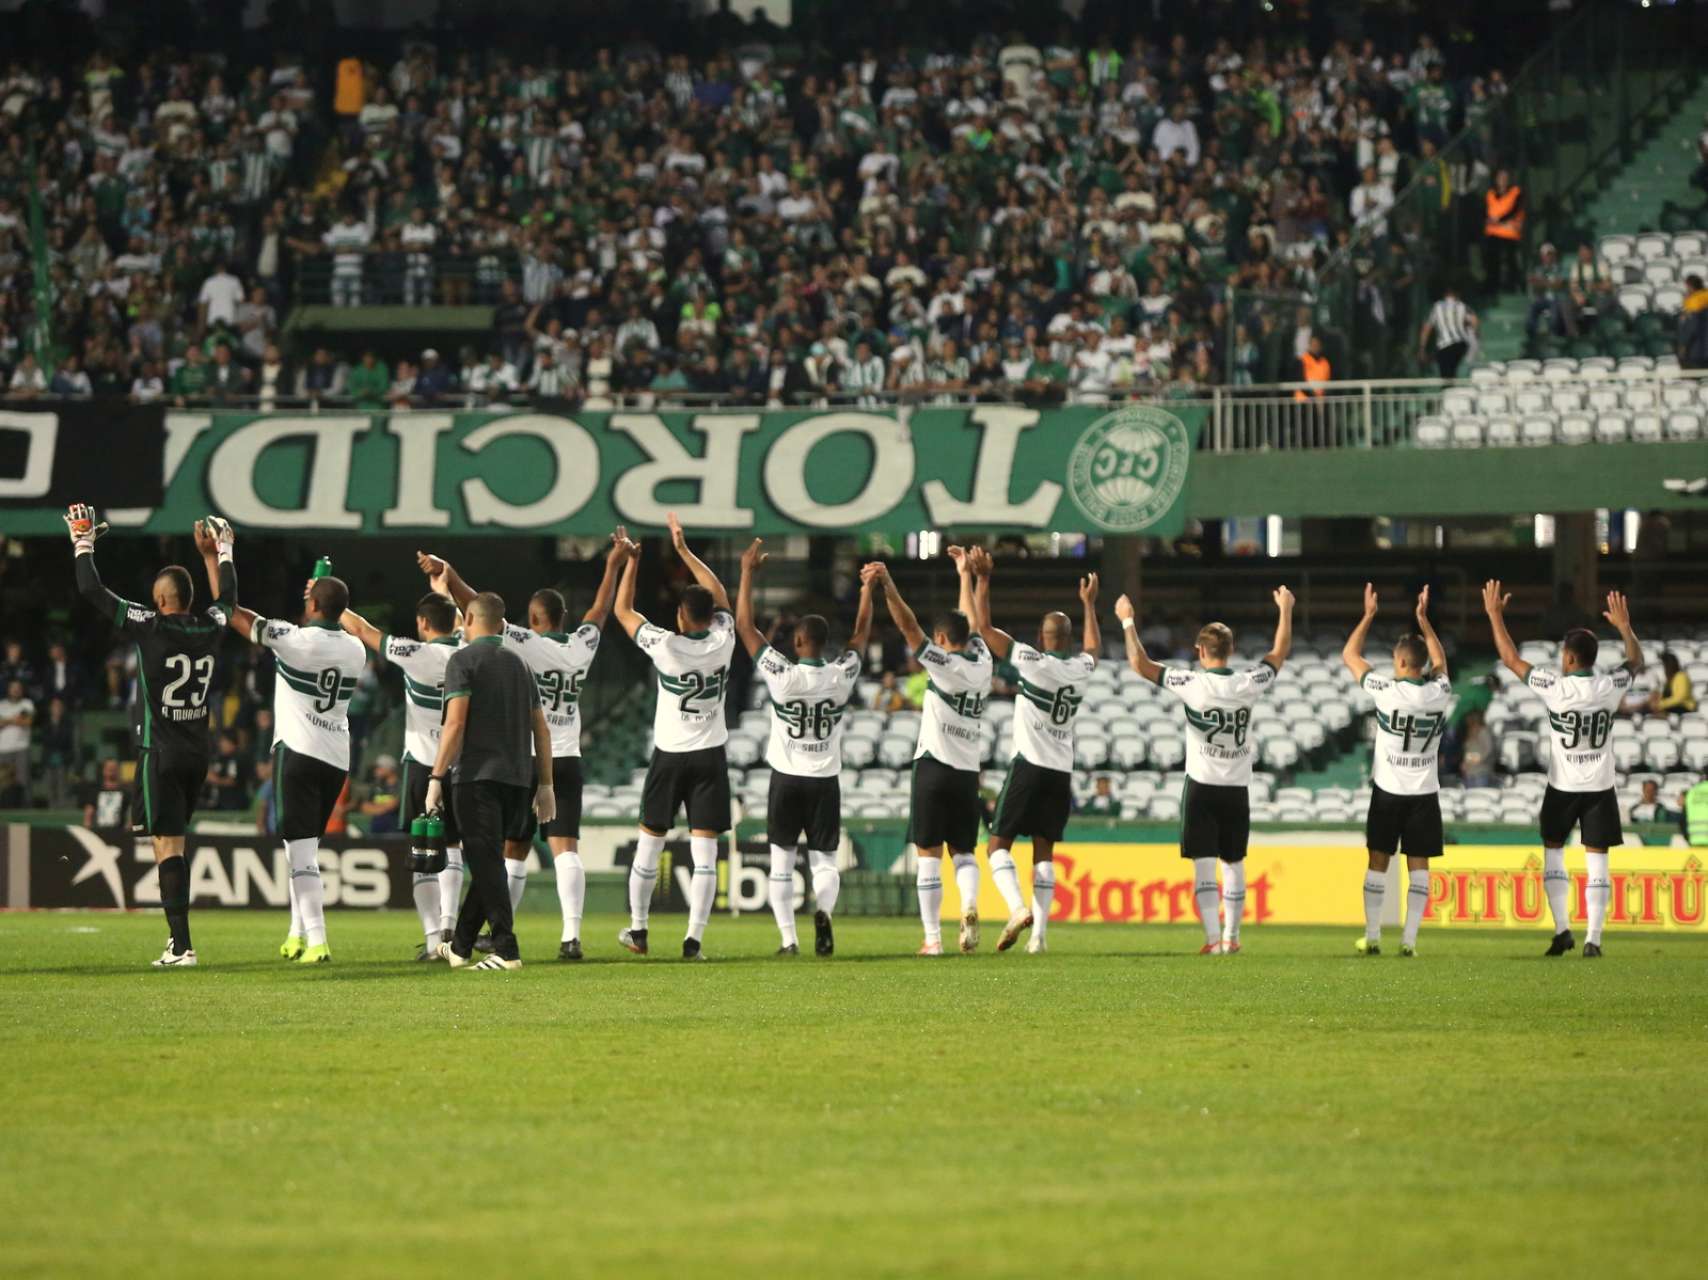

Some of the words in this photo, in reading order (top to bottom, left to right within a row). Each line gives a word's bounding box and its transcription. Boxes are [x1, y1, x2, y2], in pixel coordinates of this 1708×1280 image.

[1095, 447, 1159, 480] CFC
[161, 653, 215, 707] 23
[314, 667, 341, 714] 9
[679, 665, 727, 714] 21
[786, 699, 835, 741] 36
[1051, 684, 1076, 726] 6
[1203, 706, 1250, 748] 28
[1390, 709, 1444, 753] 47
[1559, 709, 1609, 750] 30
[1032, 852, 1273, 925] Starrt
